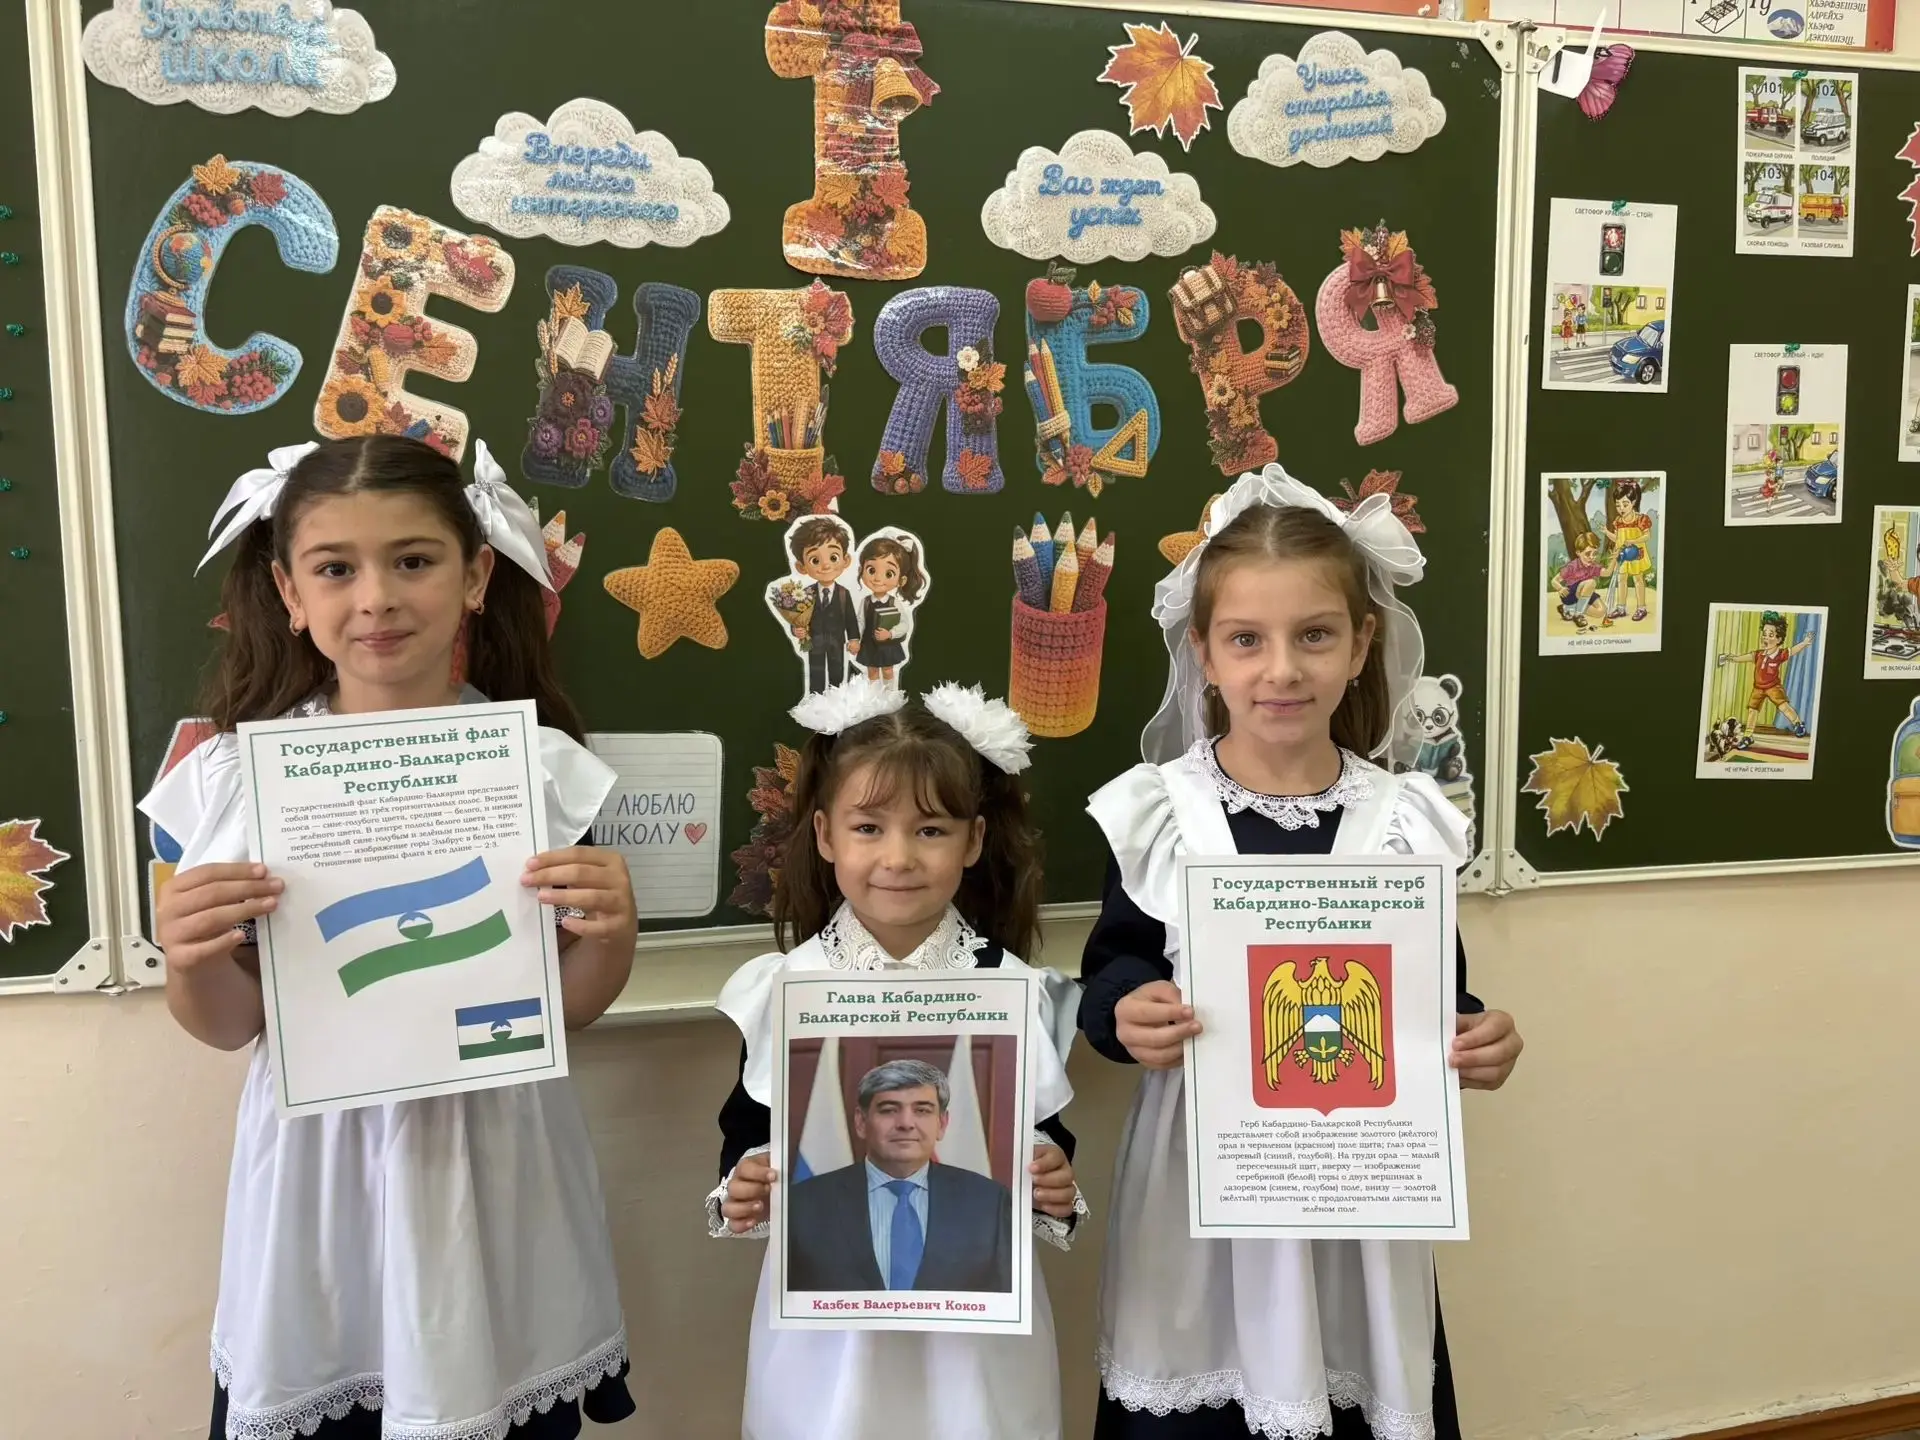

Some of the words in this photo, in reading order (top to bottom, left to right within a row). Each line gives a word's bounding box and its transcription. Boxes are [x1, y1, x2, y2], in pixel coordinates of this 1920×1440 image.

[1764, 82, 1782, 93] 101
[1817, 84, 1836, 96] 102
[524, 132, 650, 172] Впереди
[547, 171, 635, 191] много
[1038, 163, 1095, 195] Вас
[1815, 170, 1834, 181] 104
[511, 195, 679, 225] интересного
[1067, 206, 1143, 240] успех
[280, 728, 459, 757] Государственный
[465, 727, 510, 743] флаг
[283, 744, 510, 778] Кабардино-Балкарской
[343, 774, 458, 794] Республики
[616, 793, 695, 816] ЛЮБЛЮ
[593, 822, 680, 846] ШКОЛУ
[1212, 876, 1378, 893] Государственный
[1384, 876, 1425, 892] герб
[1212, 896, 1424, 913] Кабардино-Балкарской
[1264, 916, 1371, 933] Республики
[826, 991, 875, 1003] Глава
[881, 990, 982, 1006] Кабардино-
[799, 1010, 900, 1026] Балкарской
[906, 1008, 1008, 1024] Республики
[1240, 1120, 1259, 1129] Герб
[1262, 1120, 1361, 1129] Кабардино-Балкарской
[1363, 1119, 1412, 1128] Республики
[1217, 1132, 1273, 1140] представляет
[1274, 1130, 1300, 1139] собой
[1302, 1130, 1358, 1140] изображение
[1218, 1143, 1237, 1151] орла
[1294, 1140, 1335, 1150] (красном)
[1217, 1152, 1261, 1161] лазоревый
[1337, 1151, 1349, 1159] На
[1378, 1152, 1398, 1160] орла
[1411, 1151, 1439, 1159] малый
[1322, 1163, 1351, 1172] вверху
[1364, 1162, 1420, 1171] изображение
[1236, 1172, 1284, 1182] серебряной
[1286, 1172, 1316, 1182] (белой)
[1318, 1174, 1339, 1182] горы
[1348, 1174, 1368, 1182] двух
[1370, 1174, 1415, 1182] вершинах
[1302, 1183, 1338, 1193] голубом)
[1403, 1183, 1436, 1191] золотой
[1259, 1195, 1309, 1204] трилистник
[1318, 1195, 1390, 1204] продолговатыми
[813, 1300, 859, 1310] Казбек
[864, 1300, 940, 1312] Валерьевич
[945, 1300, 986, 1311] Коков
